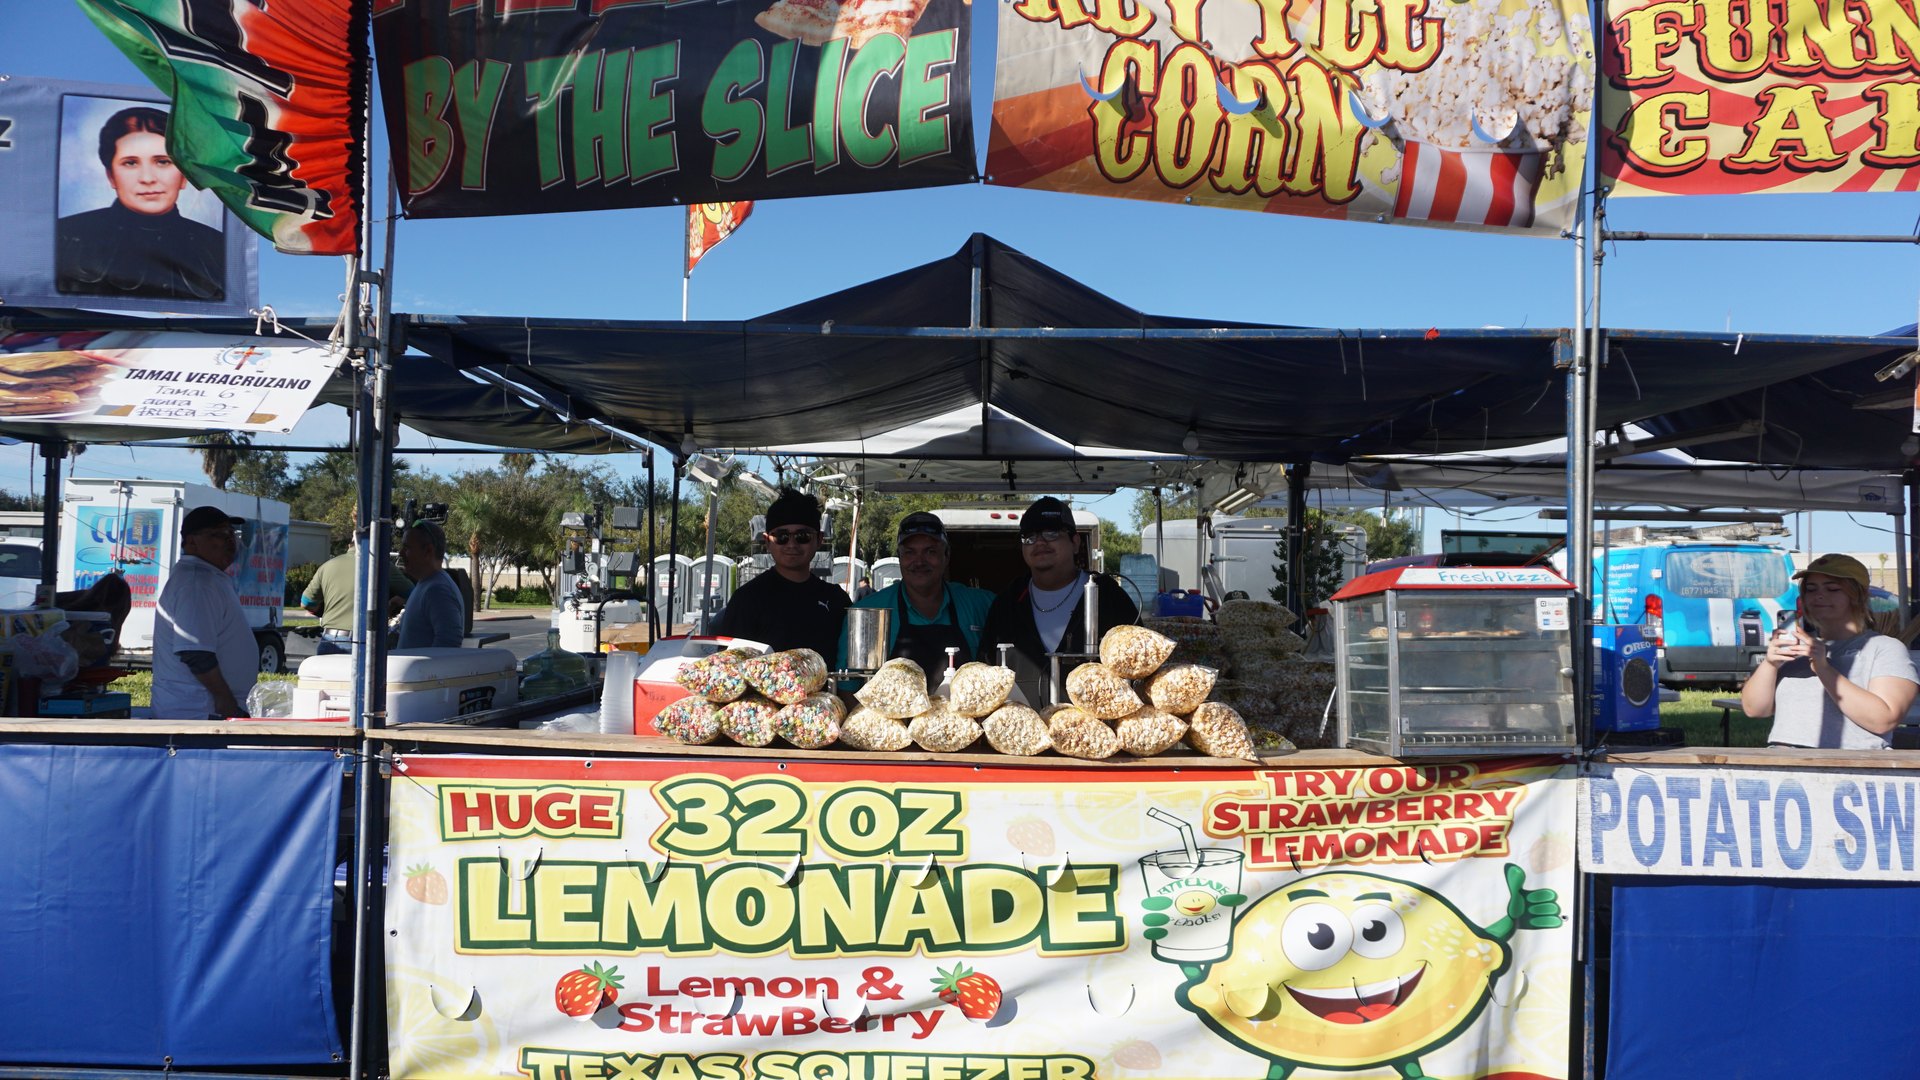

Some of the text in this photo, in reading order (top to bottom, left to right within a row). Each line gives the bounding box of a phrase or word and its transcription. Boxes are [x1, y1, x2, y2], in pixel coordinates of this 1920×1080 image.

[404, 56, 511, 196] BY
[525, 39, 680, 190] THE
[702, 27, 959, 183] SLICE
[1091, 40, 1362, 203] CORN
[124, 368, 312, 390] TAMAL VERACRUZANO
[1438, 571, 1552, 583] Fresh Pizza
[1622, 641, 1651, 655] OREO
[1264, 765, 1472, 798] TRY OUR
[449, 778, 963, 855] HUGE 32 OZ
[1213, 790, 1517, 831] STRAWBERRY
[1590, 774, 1915, 871] POTATO SW
[1250, 824, 1505, 864] LEMONADE
[461, 860, 1121, 949] LEMONADE
[647, 965, 905, 1001] Lemon &
[618, 1002, 944, 1040] StrawBerry
[522, 1049, 744, 1080] TEXAS
